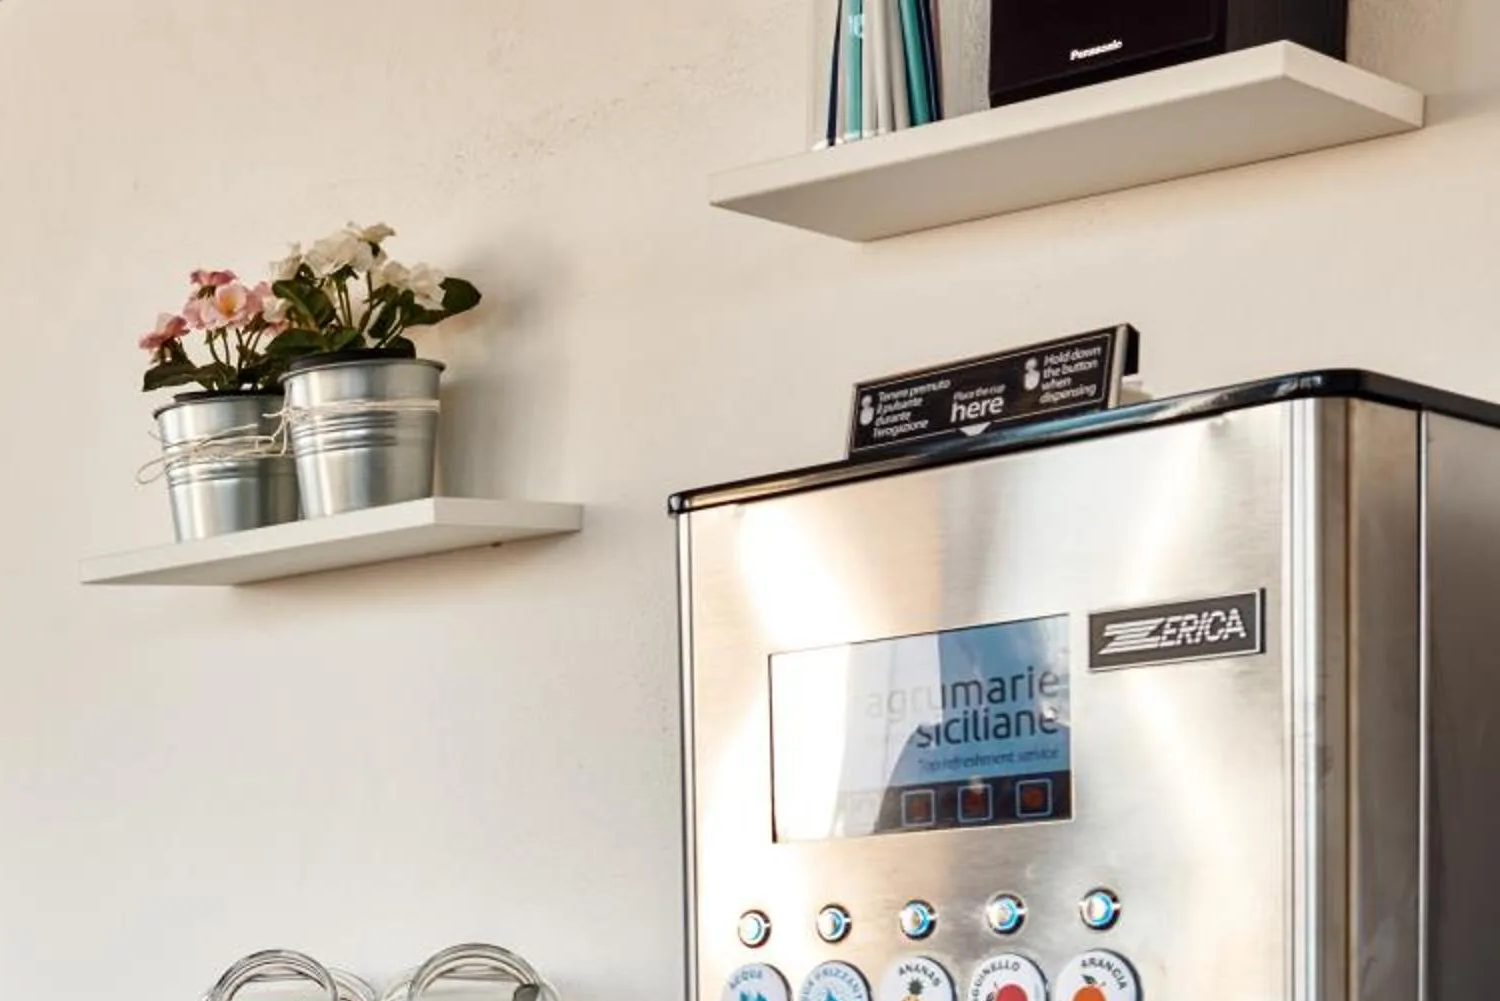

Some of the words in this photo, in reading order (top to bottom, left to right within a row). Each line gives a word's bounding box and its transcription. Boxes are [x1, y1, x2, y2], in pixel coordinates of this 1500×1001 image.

[1070, 39, 1123, 61] Panasonic
[1043, 366, 1060, 379] the
[1062, 359, 1098, 375] button
[1041, 376, 1072, 391] when
[950, 396, 1005, 423] here
[916, 705, 1061, 749] siciliane
[898, 963, 942, 988] ANANAS
[1081, 957, 1128, 991] ARANCIA
